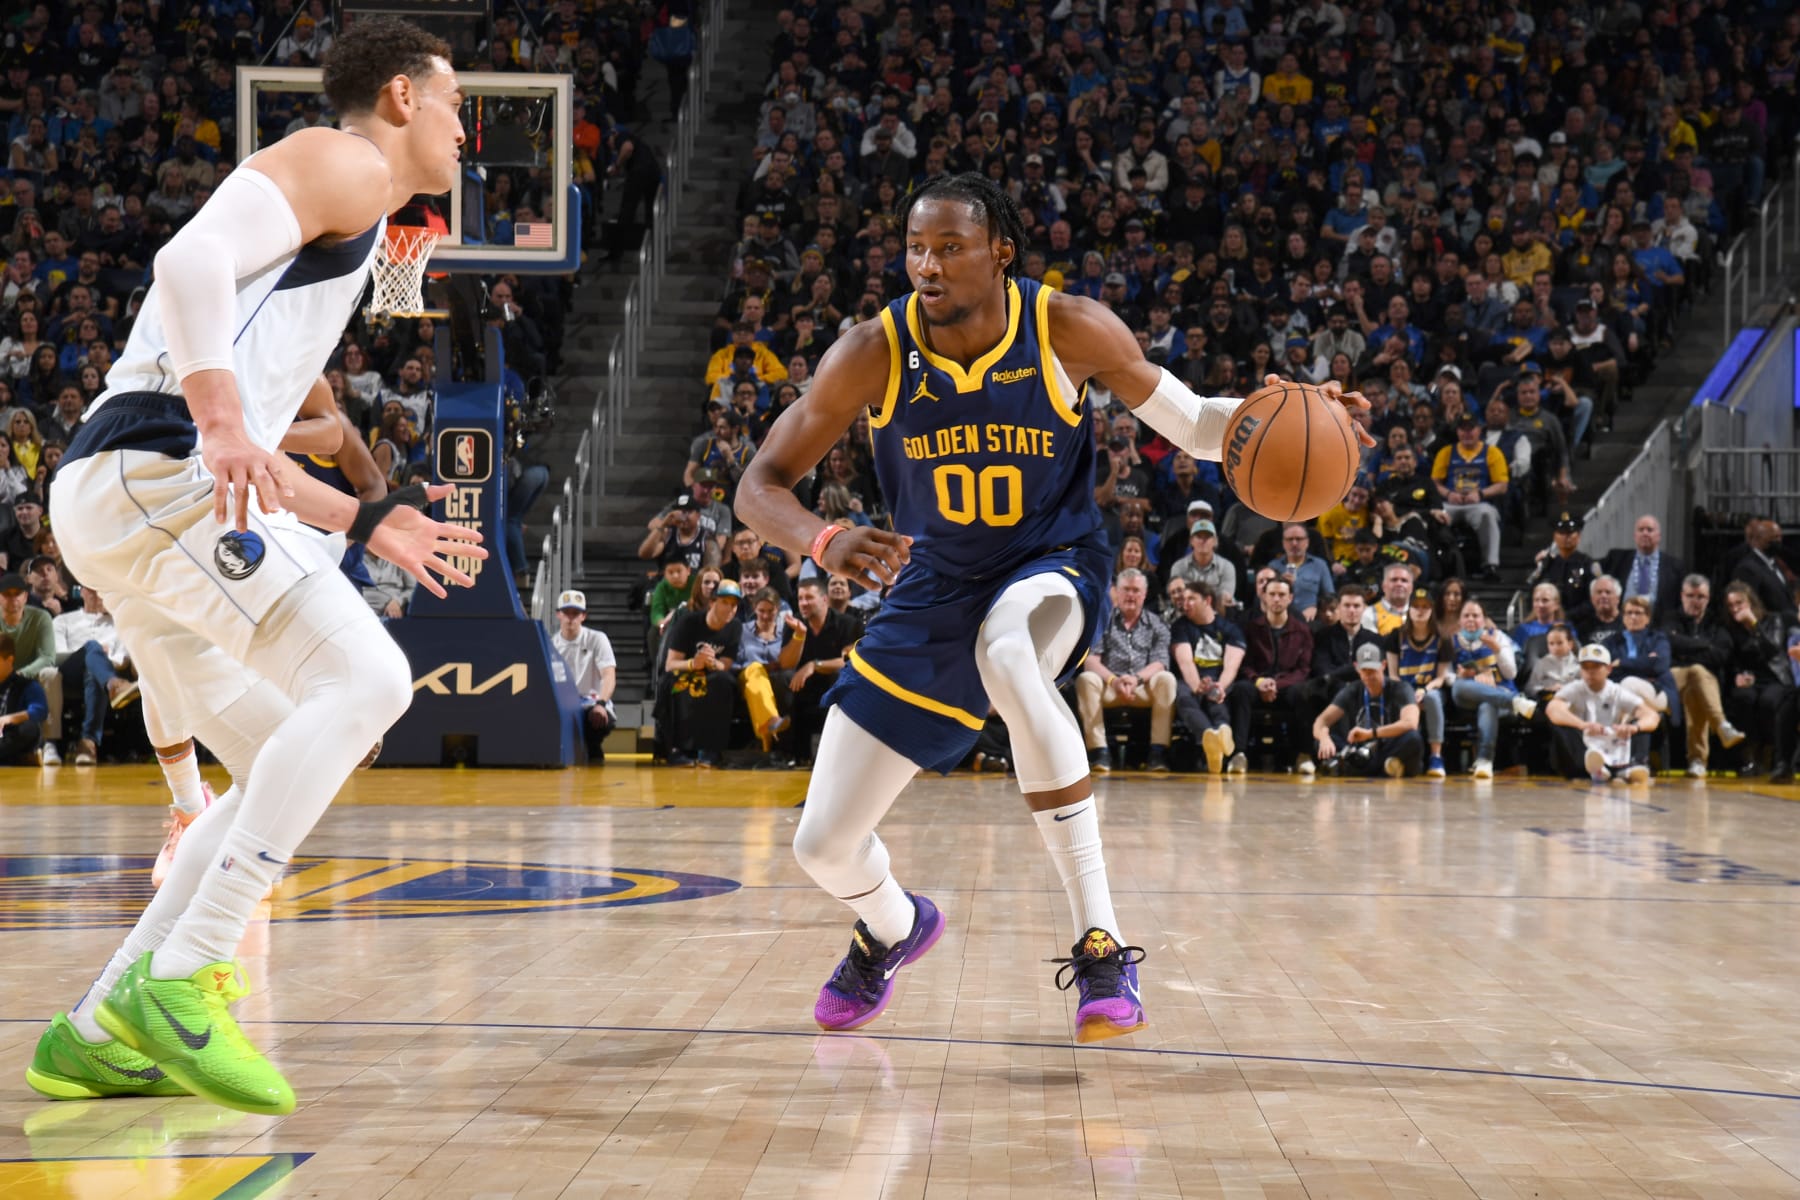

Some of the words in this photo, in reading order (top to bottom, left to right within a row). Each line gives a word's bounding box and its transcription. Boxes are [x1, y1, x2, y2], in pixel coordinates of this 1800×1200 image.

[908, 350, 920, 369] 6
[992, 367, 1037, 383] Rakuten
[903, 425, 979, 460] GOLDEN
[986, 424, 1055, 457] STATE
[445, 487, 482, 518] GET
[933, 464, 1023, 527] 00
